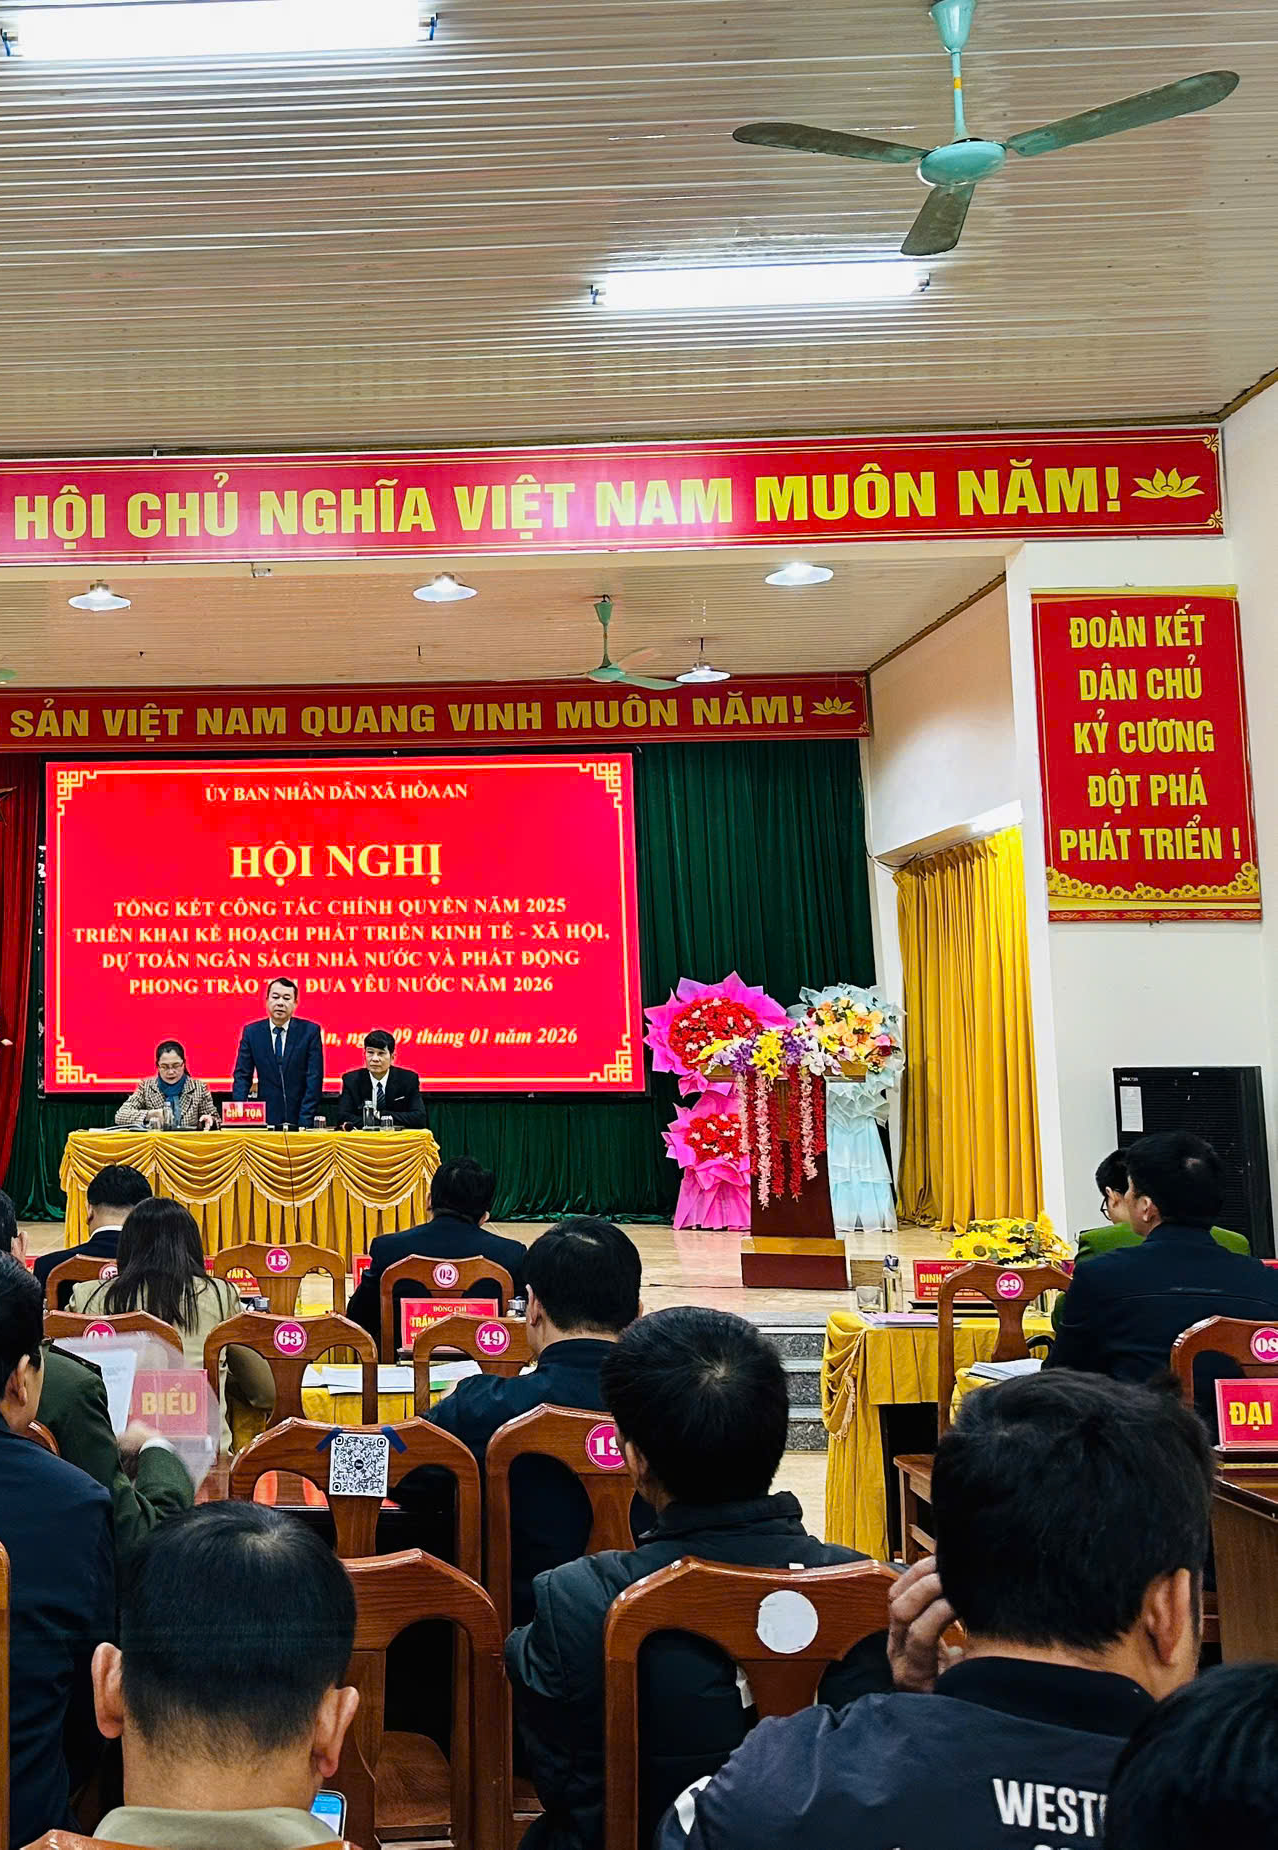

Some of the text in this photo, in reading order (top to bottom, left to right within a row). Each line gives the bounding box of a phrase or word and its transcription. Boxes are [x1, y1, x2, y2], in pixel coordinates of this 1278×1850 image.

[15, 485, 106, 549] HỘI
[127, 472, 238, 538] CHỦ
[261, 479, 436, 535] NGHĨA
[455, 475, 576, 540] VIỆT
[596, 477, 732, 526] NAM
[755, 464, 936, 522] MUÔN
[958, 459, 1120, 515] NĂM!
[1069, 604, 1205, 648] ĐOÀN KẾT
[1079, 654, 1202, 700] DÂN CHỦ
[10, 698, 88, 737] SẢN
[102, 703, 183, 744] VIỆT
[197, 707, 286, 735] NAM
[301, 705, 434, 737] QUANG
[448, 702, 541, 731] VINH
[557, 694, 678, 728] MUÔN
[692, 691, 803, 725] NĂM!
[1074, 709, 1214, 753] KỶ CƯƠNG
[234, 787, 269, 801] BAN
[274, 782, 324, 800] NHÂN
[330, 782, 367, 800] DÂN
[371, 782, 396, 799] XÃ
[1088, 767, 1207, 814] ĐỘT PHÁ
[1060, 822, 1131, 861] PHÁT
[1139, 814, 1222, 860] TRIỂN
[230, 841, 442, 886] HỘI NGHỊ
[219, 898, 276, 916] CÔNG
[328, 897, 392, 915] CHÍNH
[526, 898, 566, 912] 2025
[139, 927, 189, 942] KHAI
[227, 927, 298, 944] HOẠCH
[431, 925, 482, 940] KINH
[531, 922, 559, 939] XÃ
[102, 952, 132, 972] DỰ
[196, 948, 251, 967] NGÂN
[257, 949, 309, 967] SÁCH
[365, 949, 423, 966] NƯỚC
[462, 948, 515, 965] PHÁT
[522, 949, 580, 968] ĐỘNG
[129, 979, 198, 994] PHONG
[306, 977, 346, 992] ĐUA
[351, 973, 391, 992] YÊU
[397, 974, 456, 992] NƯỚC
[514, 977, 554, 991] 2026
[394, 1027, 577, 1047] 09 tháng 01 năm 2026
[269, 1254, 288, 1267] 15
[439, 1269, 452, 1280] 02
[999, 1280, 1019, 1290] 29
[278, 1331, 304, 1346] 63
[480, 1331, 504, 1346] 49
[142, 1382, 196, 1416] BIỂU
[1229, 1401, 1272, 1430] ĐẠI
